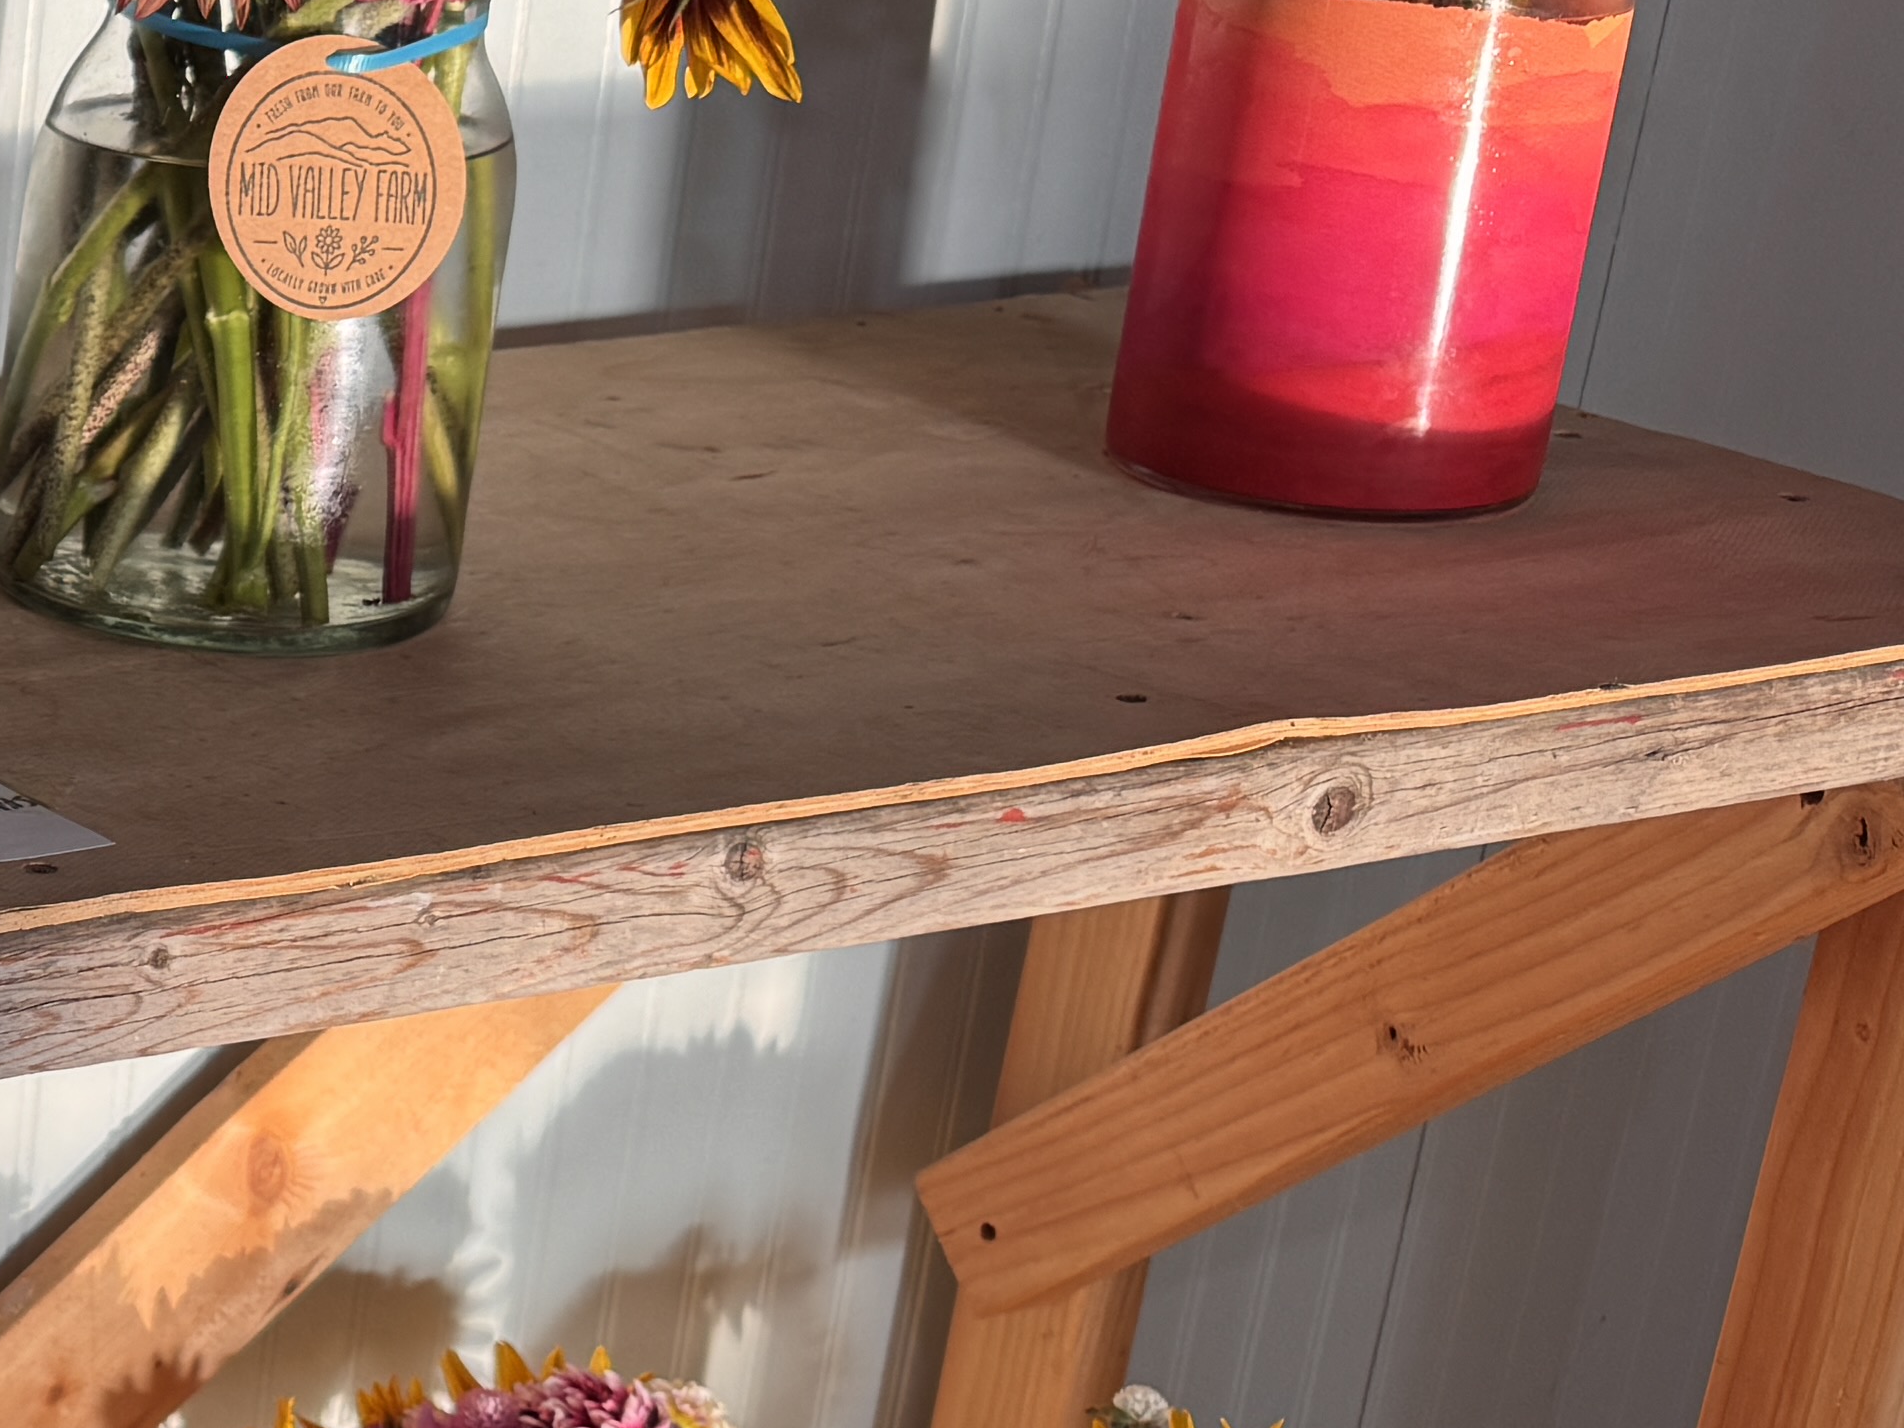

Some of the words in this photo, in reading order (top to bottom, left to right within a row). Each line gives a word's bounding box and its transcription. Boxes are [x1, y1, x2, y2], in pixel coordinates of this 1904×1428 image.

[294, 83, 321, 104] FROM
[349, 86, 373, 107] FARM
[375, 99, 389, 115] TO
[387, 110, 406, 131] YOU
[238, 161, 280, 217] MID
[289, 164, 367, 221] VALLEY
[374, 169, 428, 226] FARM
[266, 262, 305, 291] LOCALLY
[340, 279, 362, 294] WITH
